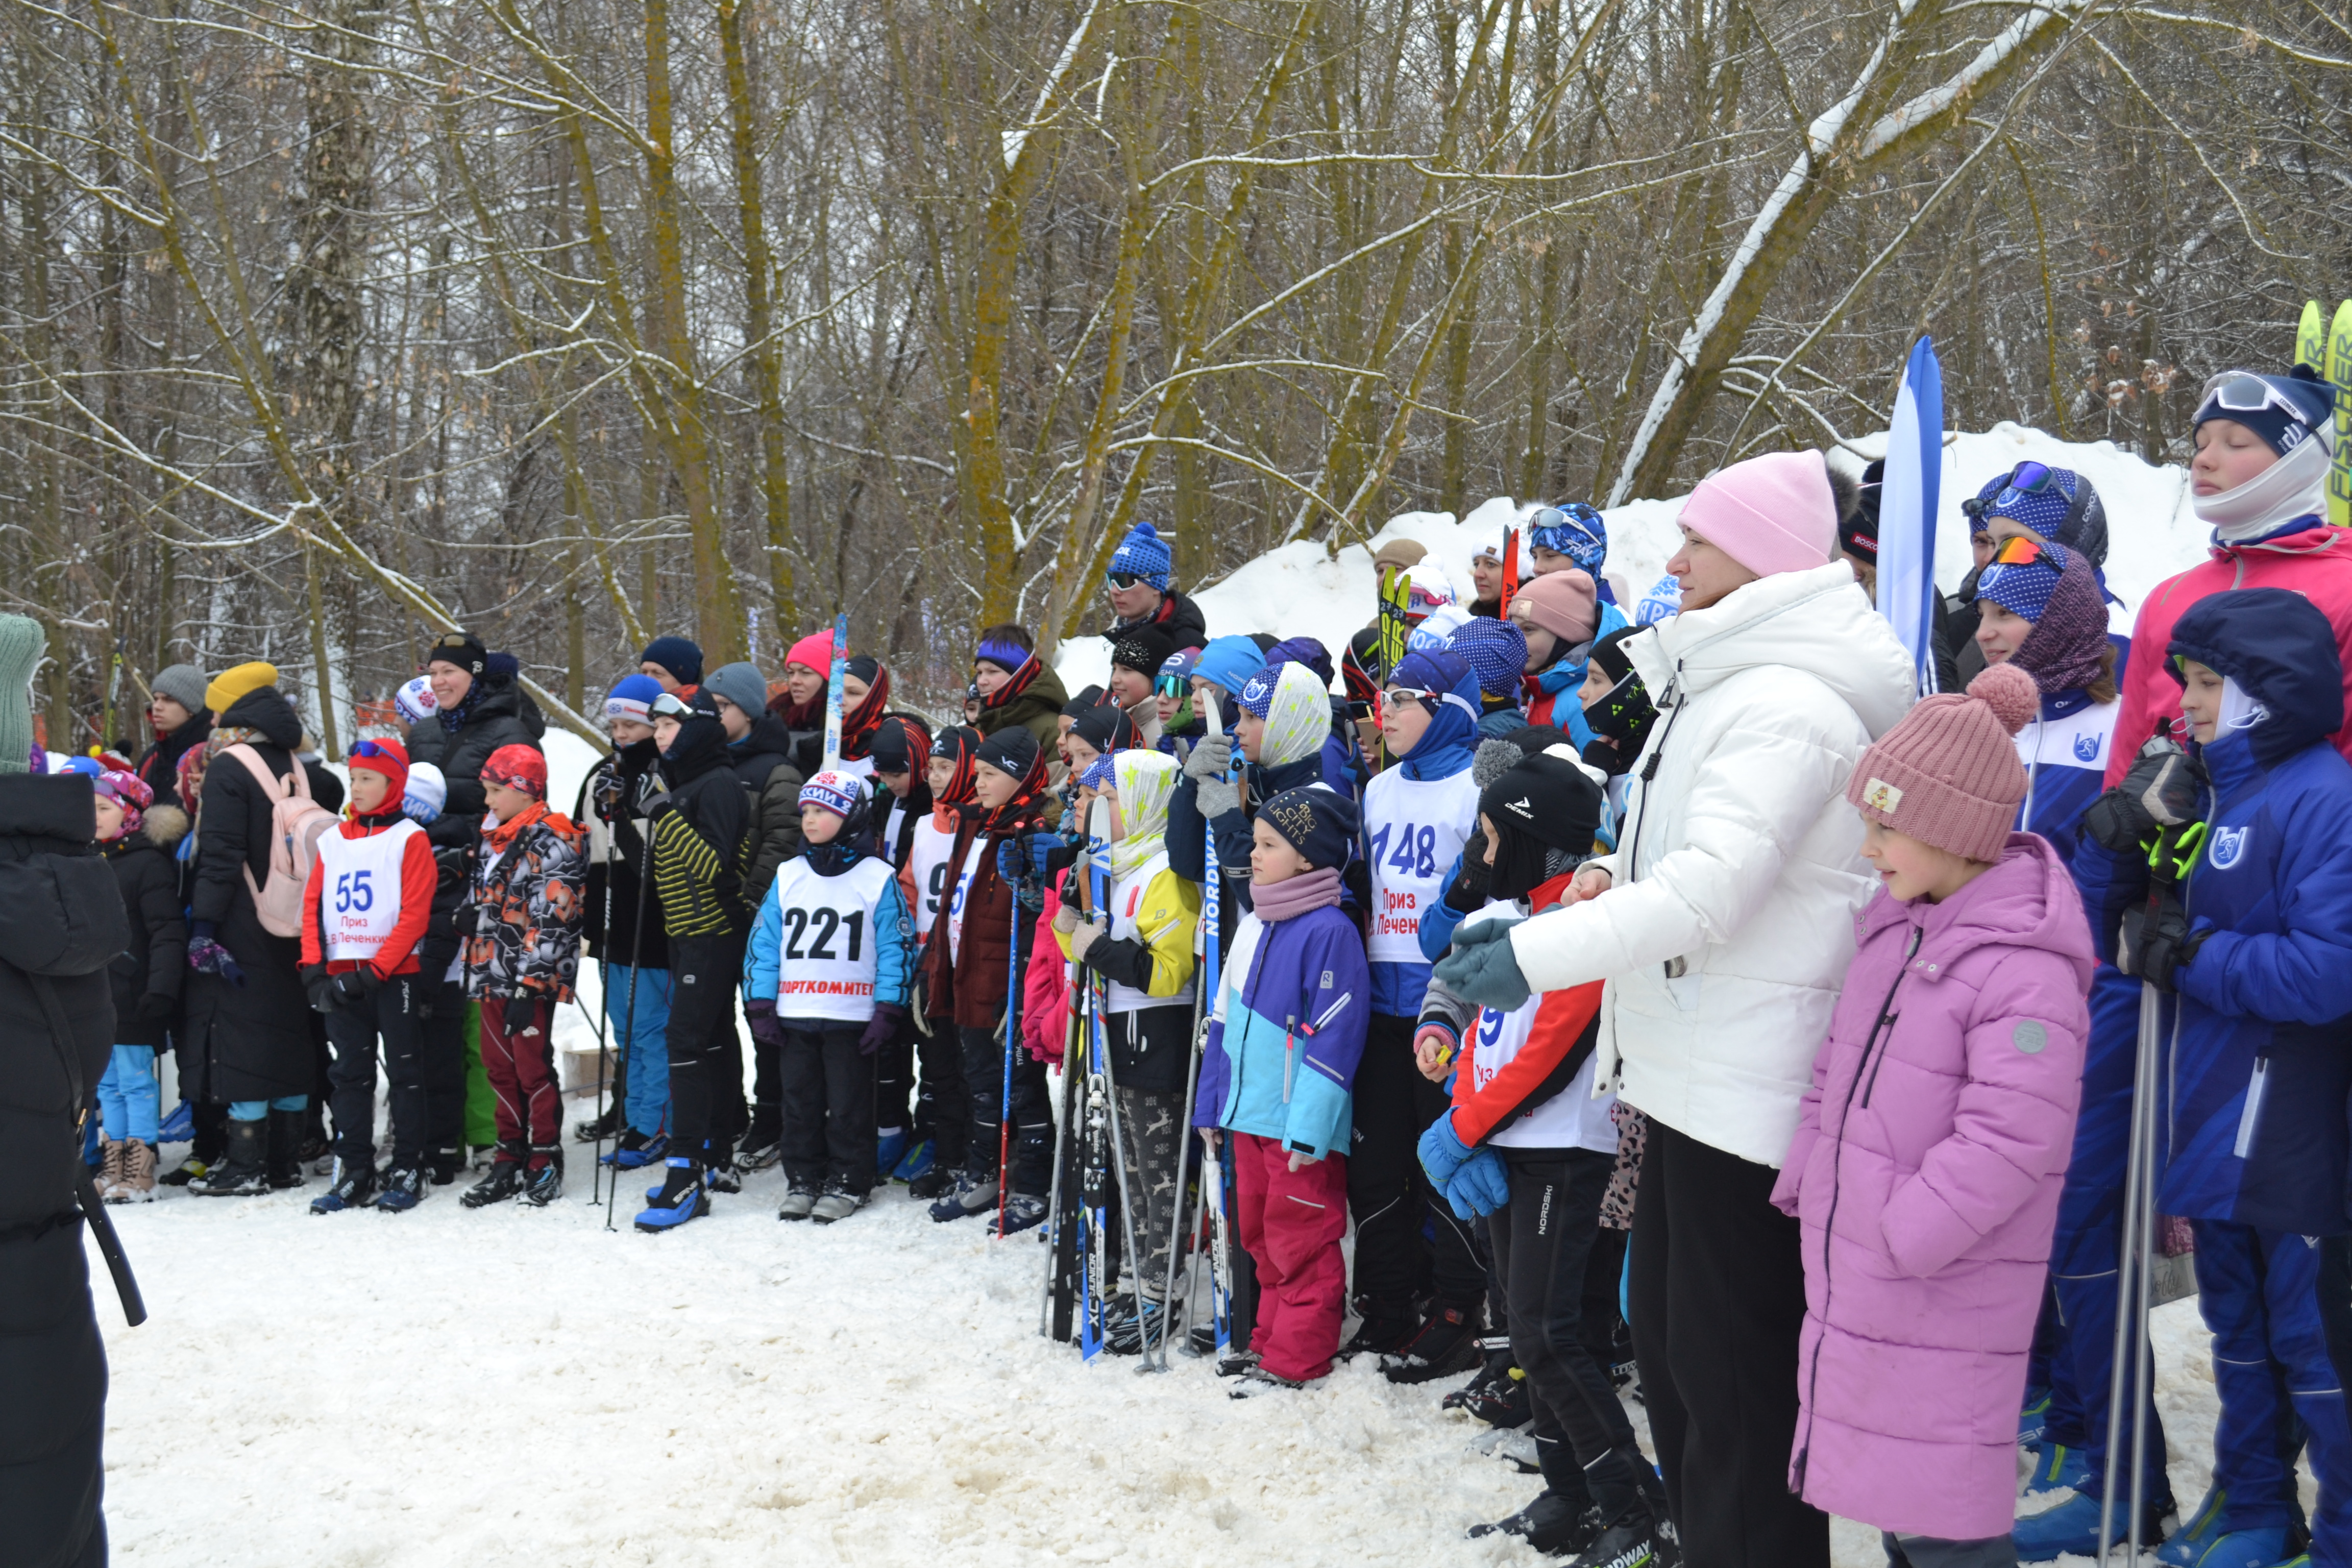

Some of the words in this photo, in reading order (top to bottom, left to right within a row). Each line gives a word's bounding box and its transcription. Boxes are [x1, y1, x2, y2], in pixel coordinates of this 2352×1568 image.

[1854, 536, 1878, 550] BOSCO
[1268, 803, 1306, 845] LIGHTS
[1286, 807, 1312, 835] CITY
[1504, 802, 1534, 819] DEMIX
[1371, 822, 1436, 878] 148
[336, 870, 374, 912] 55
[1383, 887, 1416, 915] Приз
[341, 916, 369, 929] Приз
[784, 906, 865, 962] 221
[1377, 913, 1422, 936] Печен
[338, 932, 389, 944] Печенки
[1538, 1185, 1553, 1235] NORDSKI
[1088, 1253, 1097, 1297] JUNIOR
[1088, 1298, 1099, 1327] XC
[1603, 1538, 1651, 1568] DWAY
